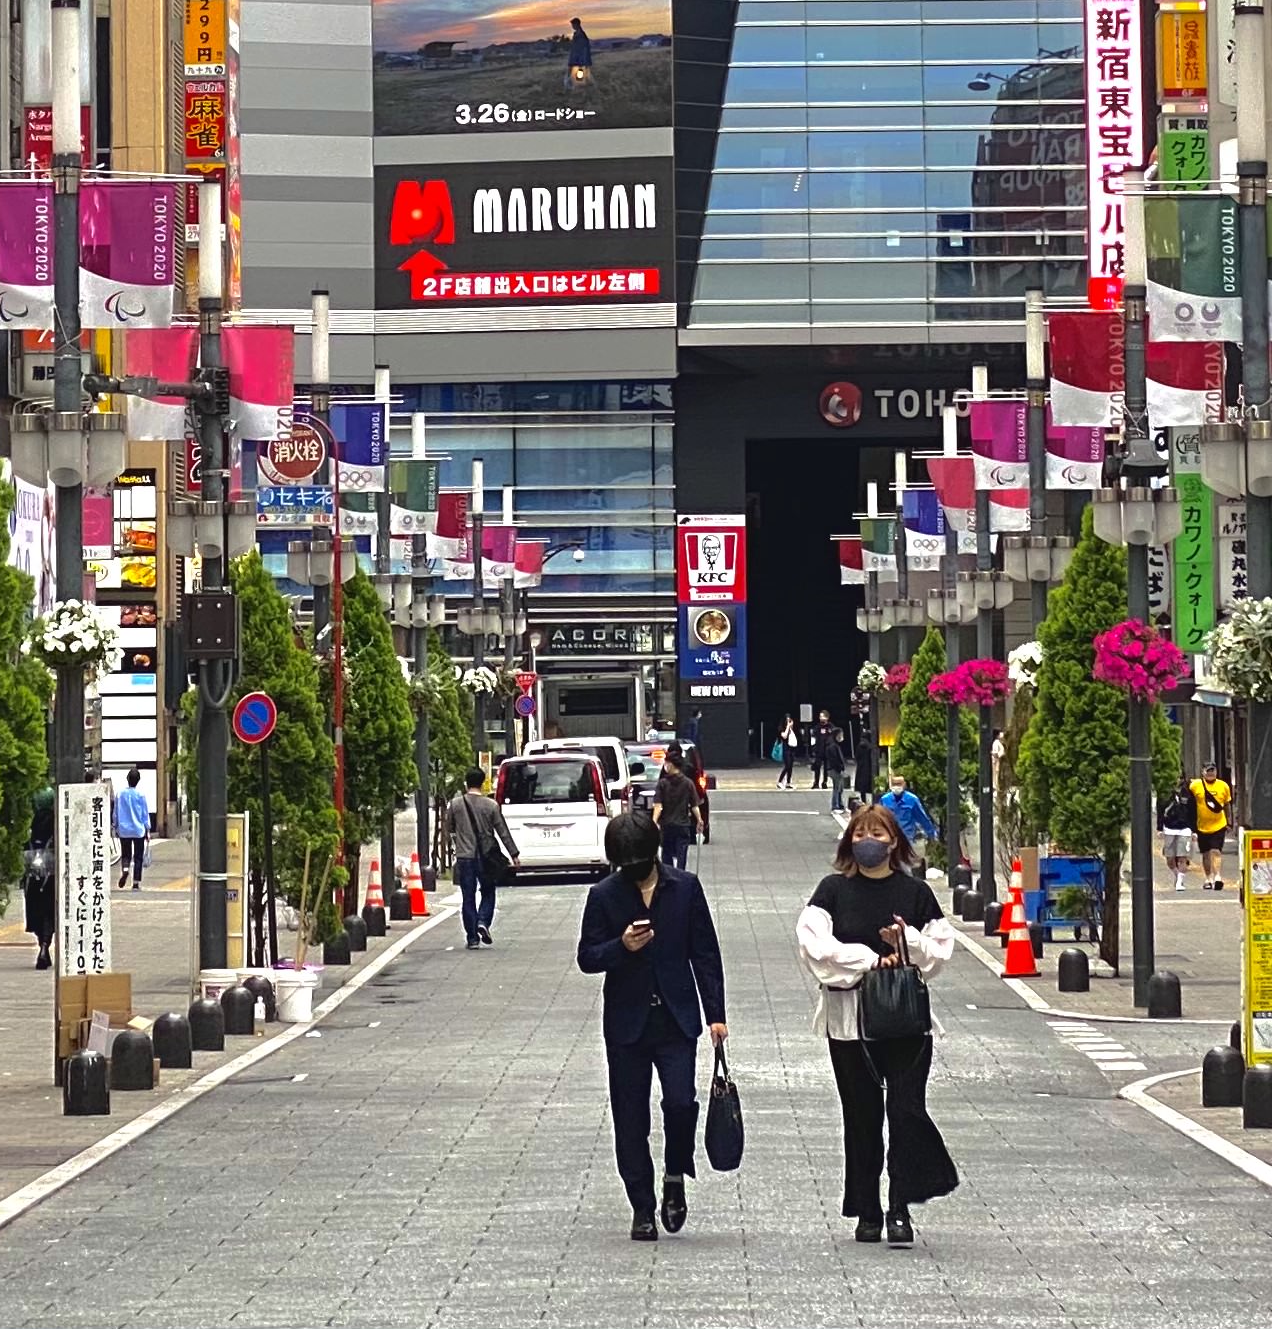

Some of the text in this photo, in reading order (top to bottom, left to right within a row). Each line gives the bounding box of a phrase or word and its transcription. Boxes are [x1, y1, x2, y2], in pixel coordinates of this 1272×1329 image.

[185, 96, 222, 150] 麻雀
[455, 103, 596, 125] 3.26(金) ロードショー
[471, 182, 657, 234] MARUHAN
[34, 195, 49, 282] TOKYO 2020
[153, 195, 168, 281] TOKYO 2020
[1221, 206, 1235, 294] TOKYO 2020
[1109, 311, 1125, 428] TOKYO 2020
[273, 438, 320, 463] 消火栓
[371, 410, 381, 463] TOKYO 2020
[276, 487, 334, 506] セキネ
[696, 572, 728, 583] KFC
[690, 685, 737, 697] NEW OPEN
[91, 796, 105, 975] 客引きに声をかけられた
